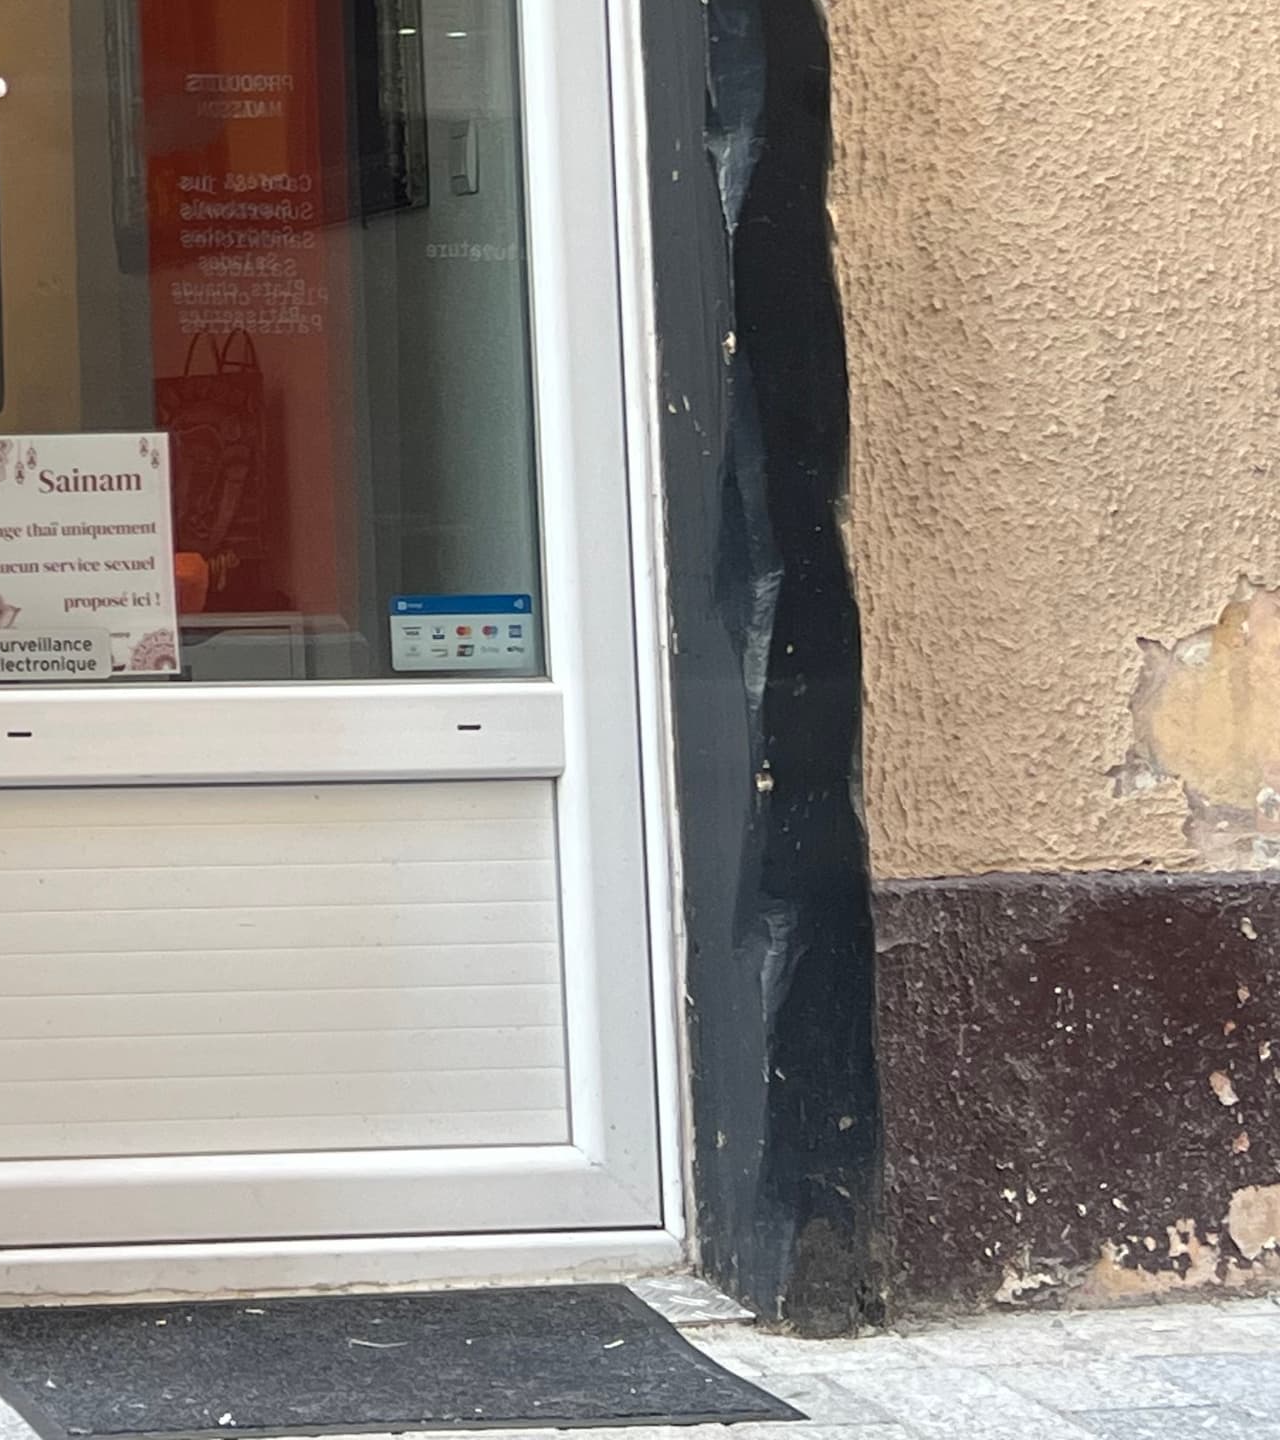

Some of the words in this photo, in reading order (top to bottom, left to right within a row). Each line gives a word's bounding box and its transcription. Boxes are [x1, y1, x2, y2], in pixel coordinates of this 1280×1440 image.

[38, 468, 142, 494] Sainam
[26, 522, 58, 537] thaï
[61, 522, 156, 539] uniquement
[42, 558, 101, 573] service
[104, 556, 155, 572] sexuel
[63, 592, 128, 612] proposé
[132, 592, 152, 608] ici
